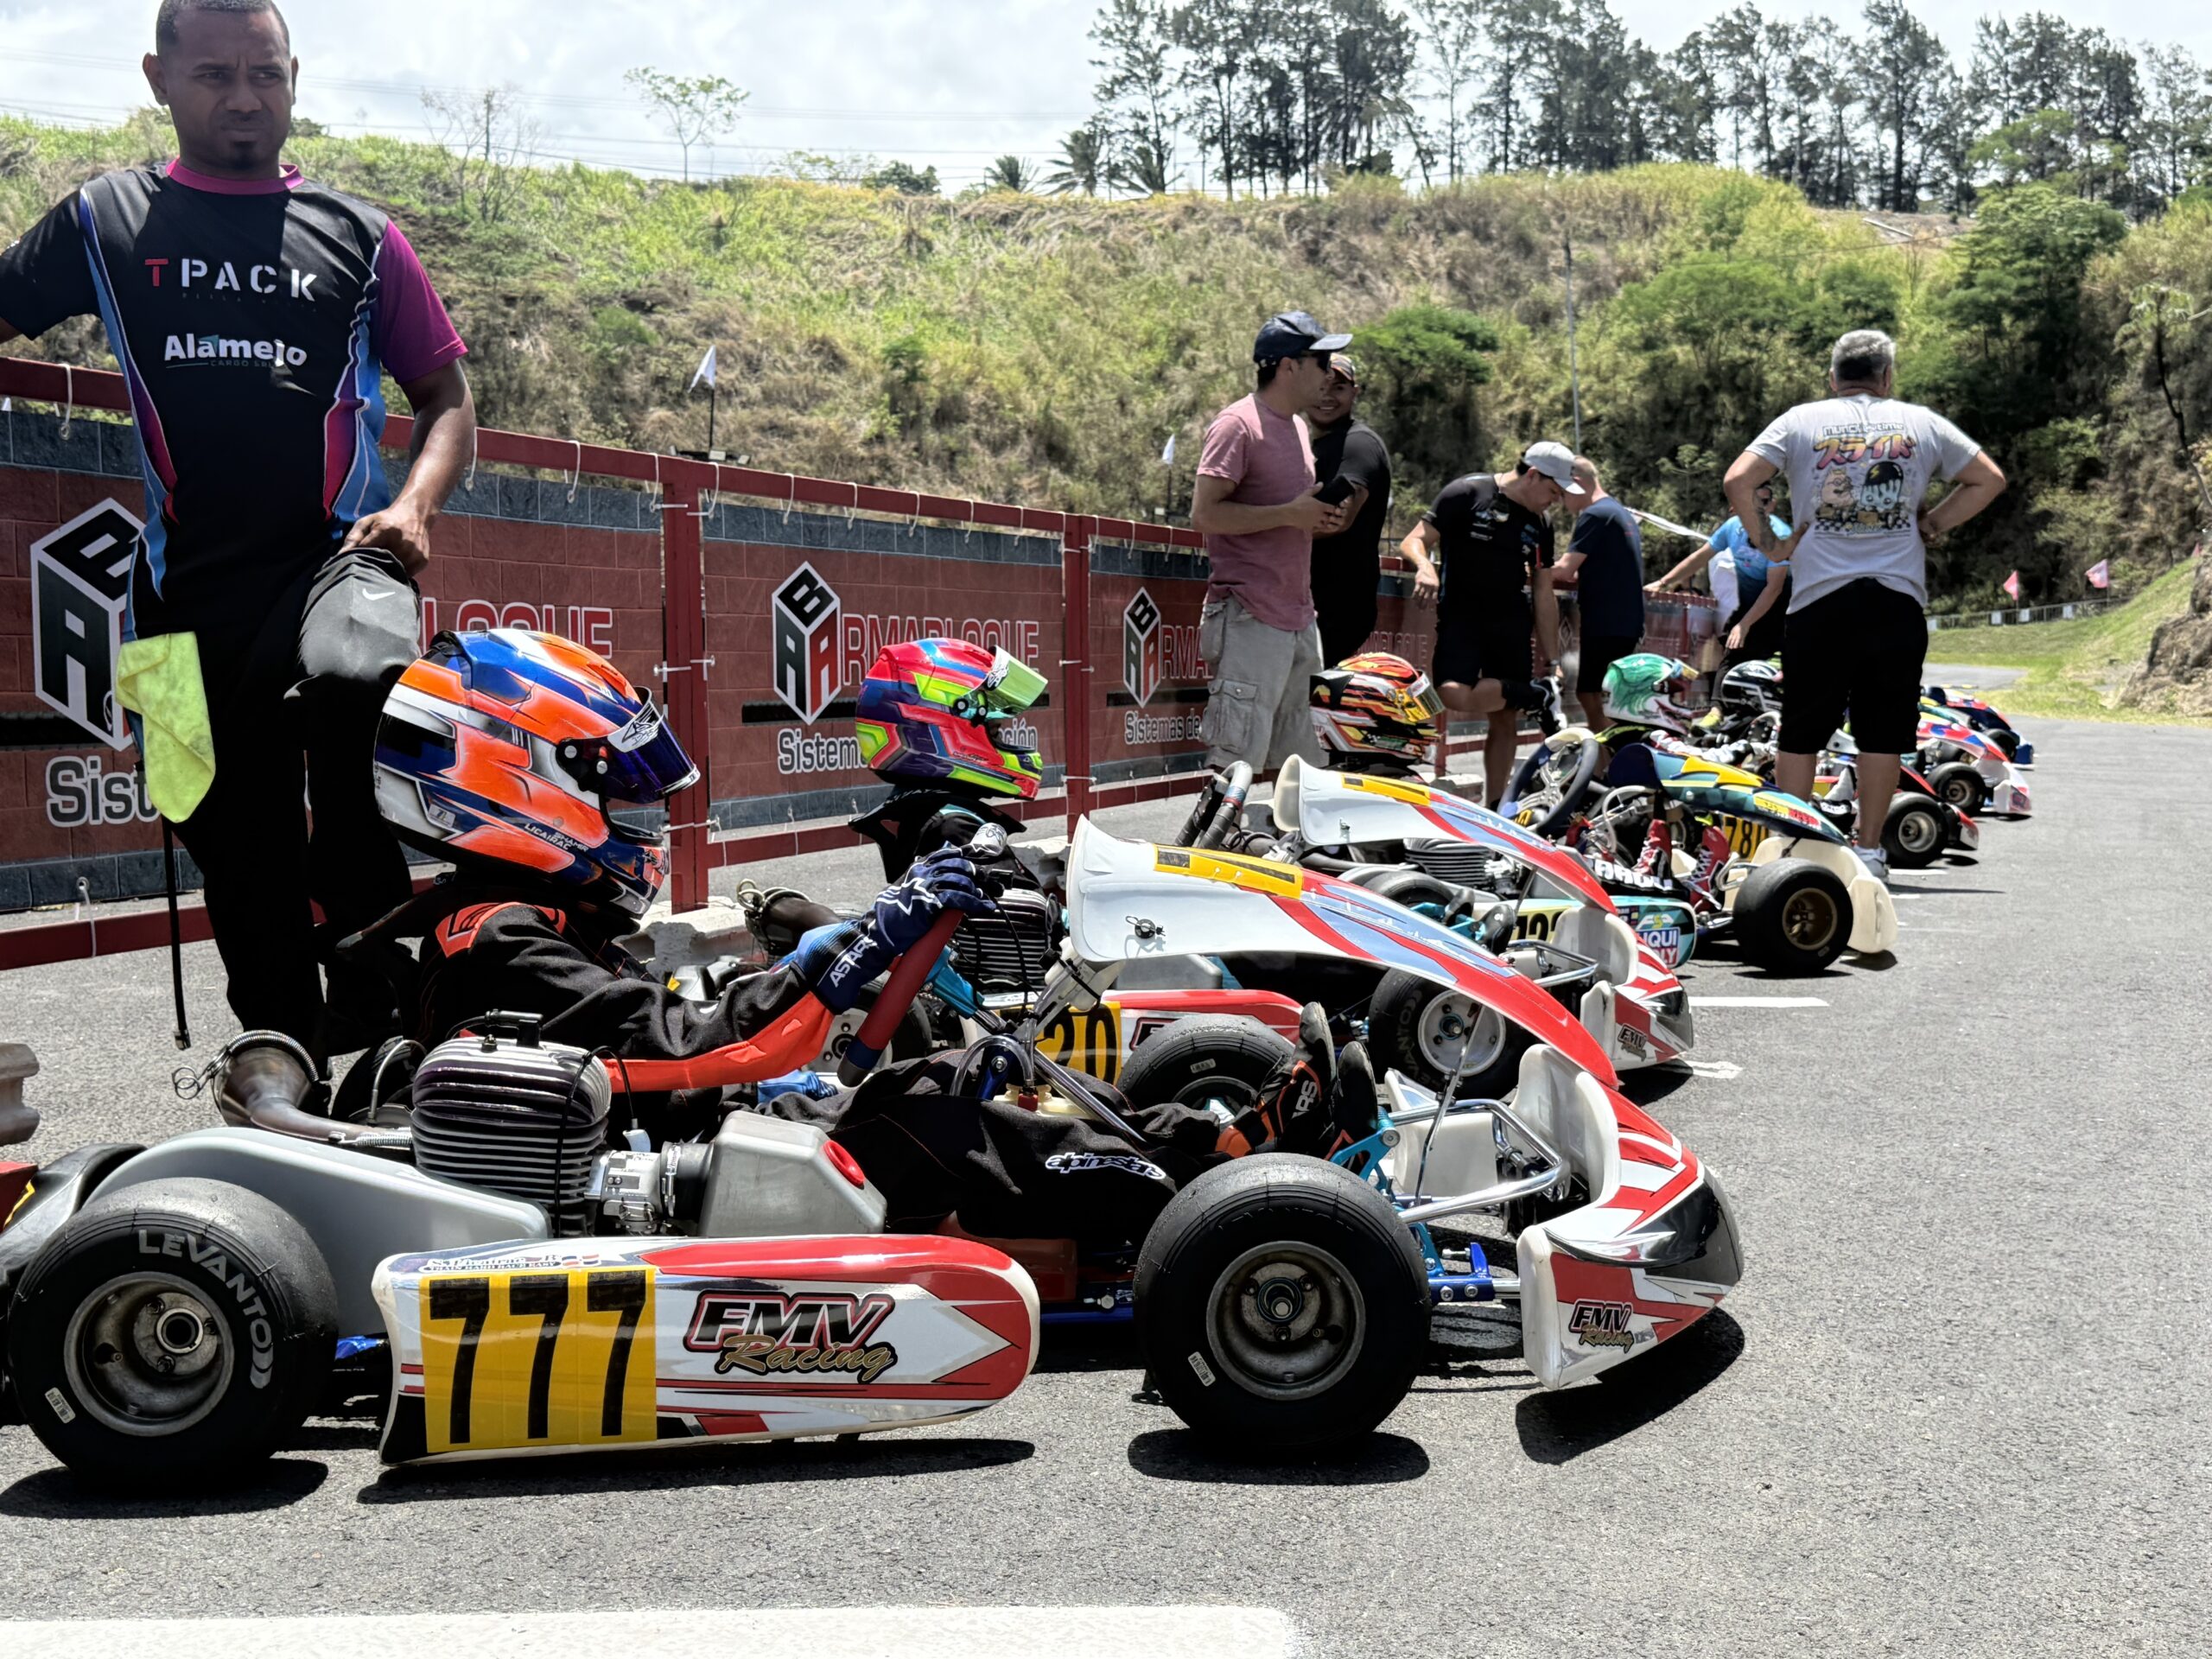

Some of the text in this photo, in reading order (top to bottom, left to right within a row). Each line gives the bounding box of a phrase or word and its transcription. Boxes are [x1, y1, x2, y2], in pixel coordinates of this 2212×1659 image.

[1125, 710, 1184, 745] Sistemas
[524, 823, 572, 851] LICAIRAC
[553, 831, 588, 852] SHAMIR
[1643, 930, 1677, 948] IQUI
[138, 1229, 273, 1350] LEVANTO
[690, 1298, 890, 1347] FMV
[1572, 1304, 1632, 1332] FMV
[1580, 1323, 1633, 1353] Racing
[429, 1270, 646, 1444] 777
[719, 1334, 894, 1382] Racing
